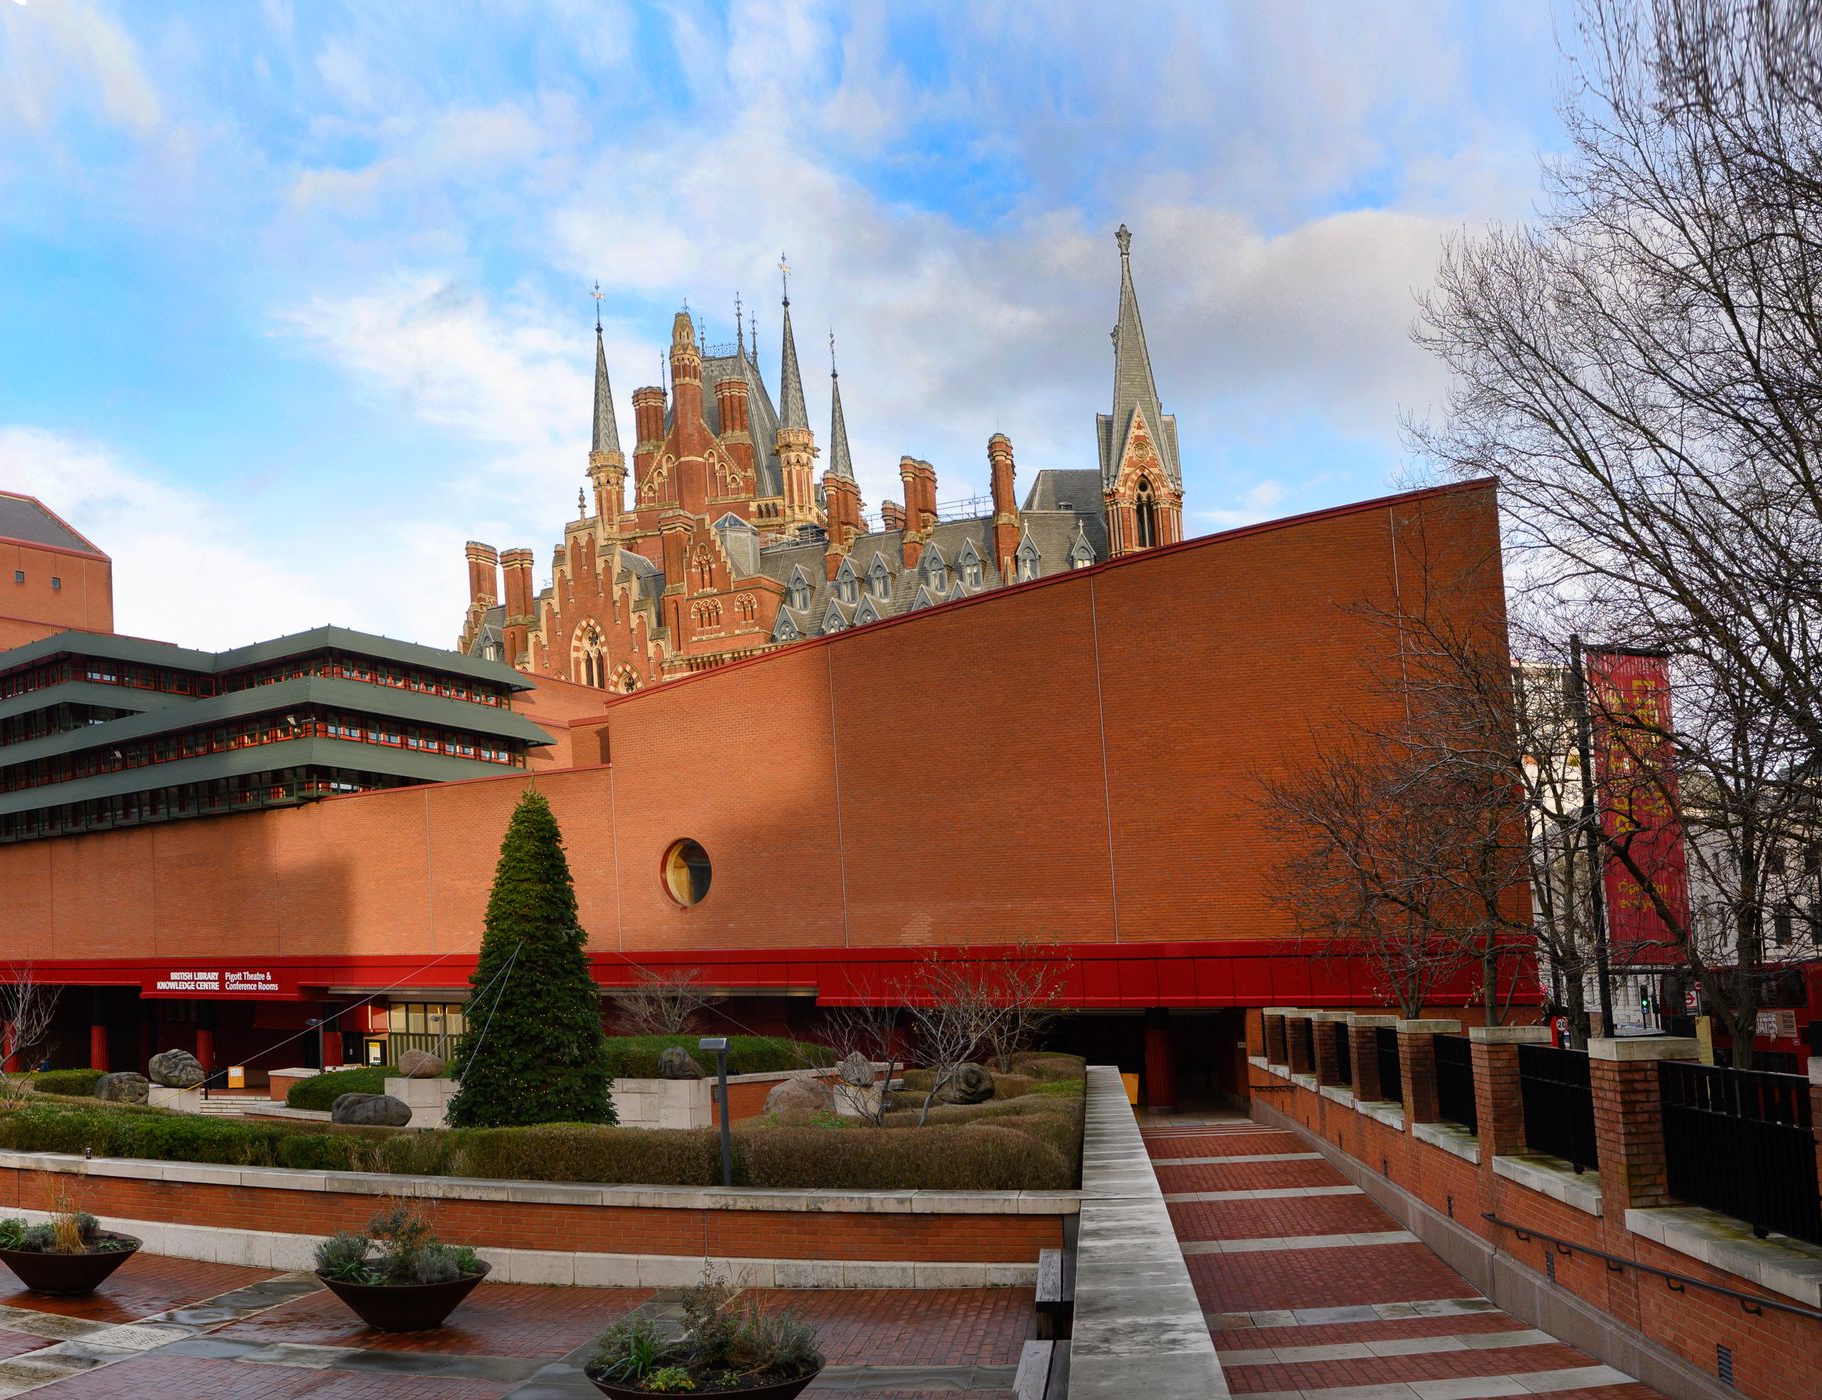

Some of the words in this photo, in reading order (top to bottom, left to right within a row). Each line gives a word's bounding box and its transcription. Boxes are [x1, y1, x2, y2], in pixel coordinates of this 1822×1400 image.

[170, 972, 193, 980] BRITISH
[194, 972, 219, 980] LIBRARY
[225, 972, 242, 982] Pigott
[244, 972, 265, 980] Theatre
[266, 972, 272, 980] &
[157, 982, 195, 990] KNOWLEDGE
[196, 982, 220, 990] CENTRE
[225, 982, 257, 990] Conference
[258, 982, 279, 991] Rooms
